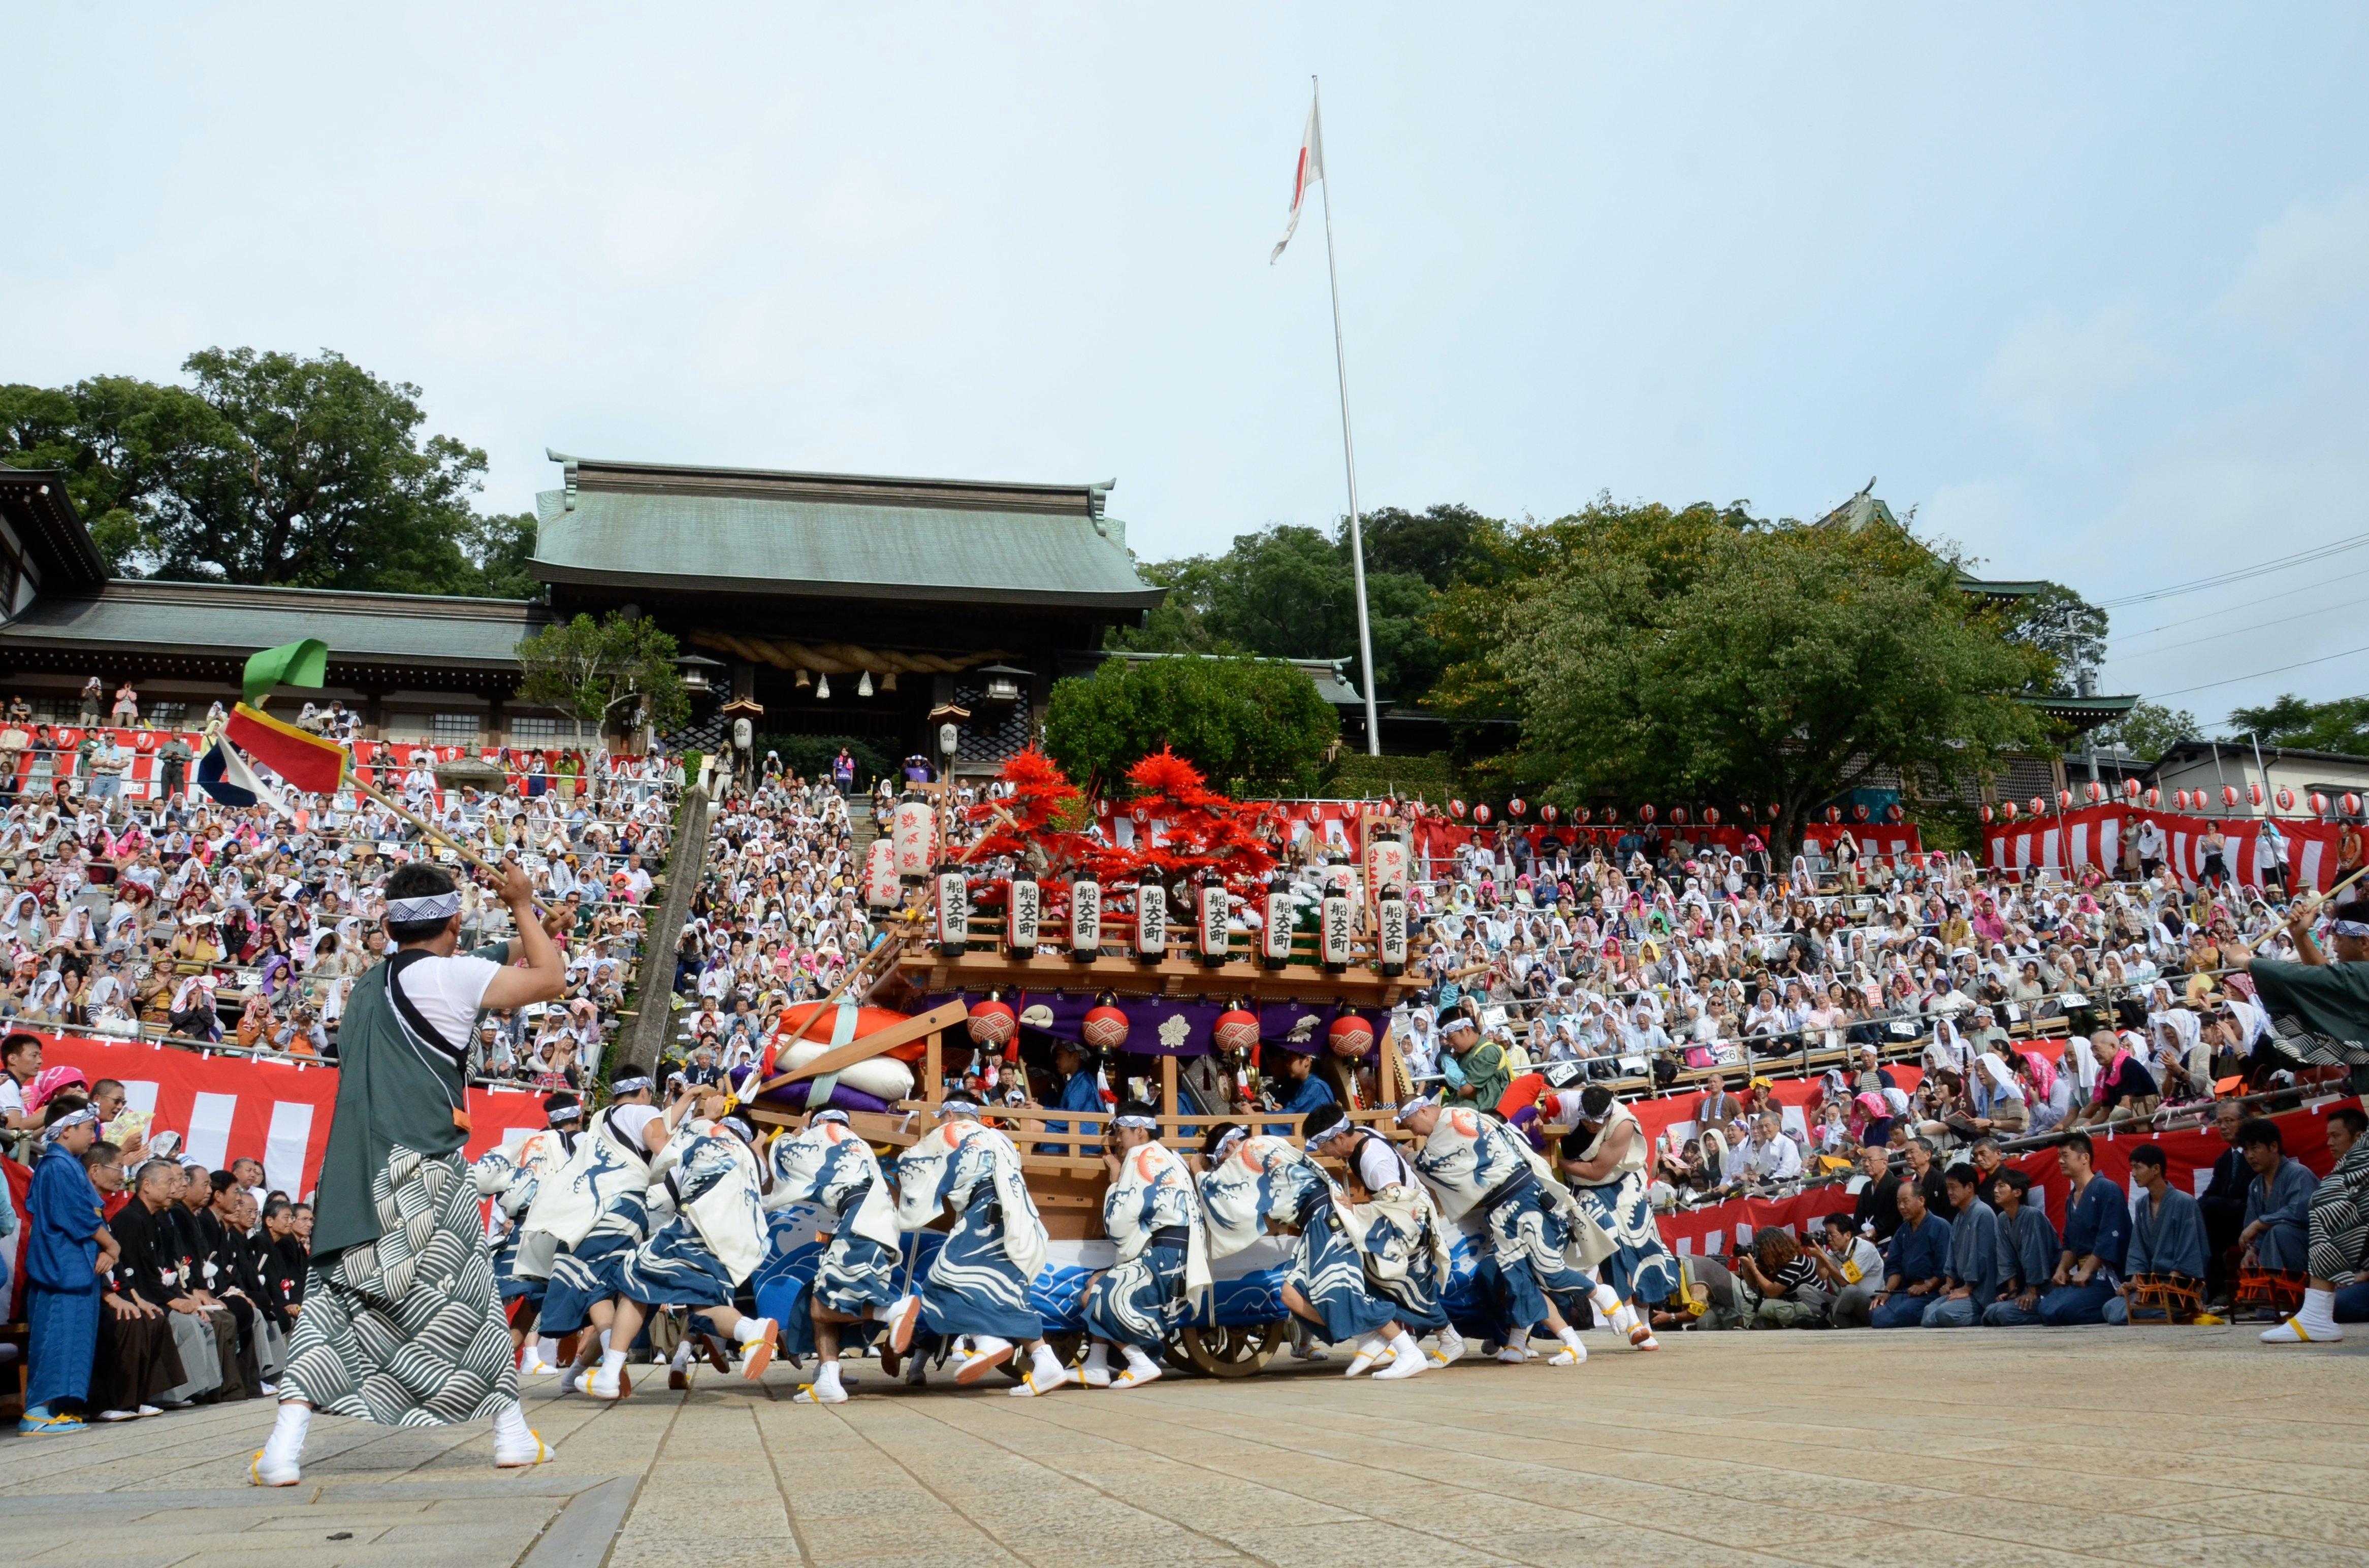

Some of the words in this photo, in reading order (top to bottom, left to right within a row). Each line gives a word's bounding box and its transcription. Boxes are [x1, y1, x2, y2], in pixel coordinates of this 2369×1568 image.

[523, 856, 538, 864] Q-2
[946, 878, 966, 933] 船大工町
[1019, 885, 1040, 938] 船大工町
[1078, 888, 1097, 938] 船大工町
[1144, 891, 1164, 943] 船大工町
[1208, 894, 1228, 945] 船大工町
[1272, 901, 1292, 950] 船大工町
[1330, 902, 1349, 954] 船大工町
[1384, 905, 1403, 953] 船大工町
[2063, 996, 2085, 1005] K-10
[1892, 1024, 1913, 1033] K-8
[1552, 1065, 1574, 1083] K-4
